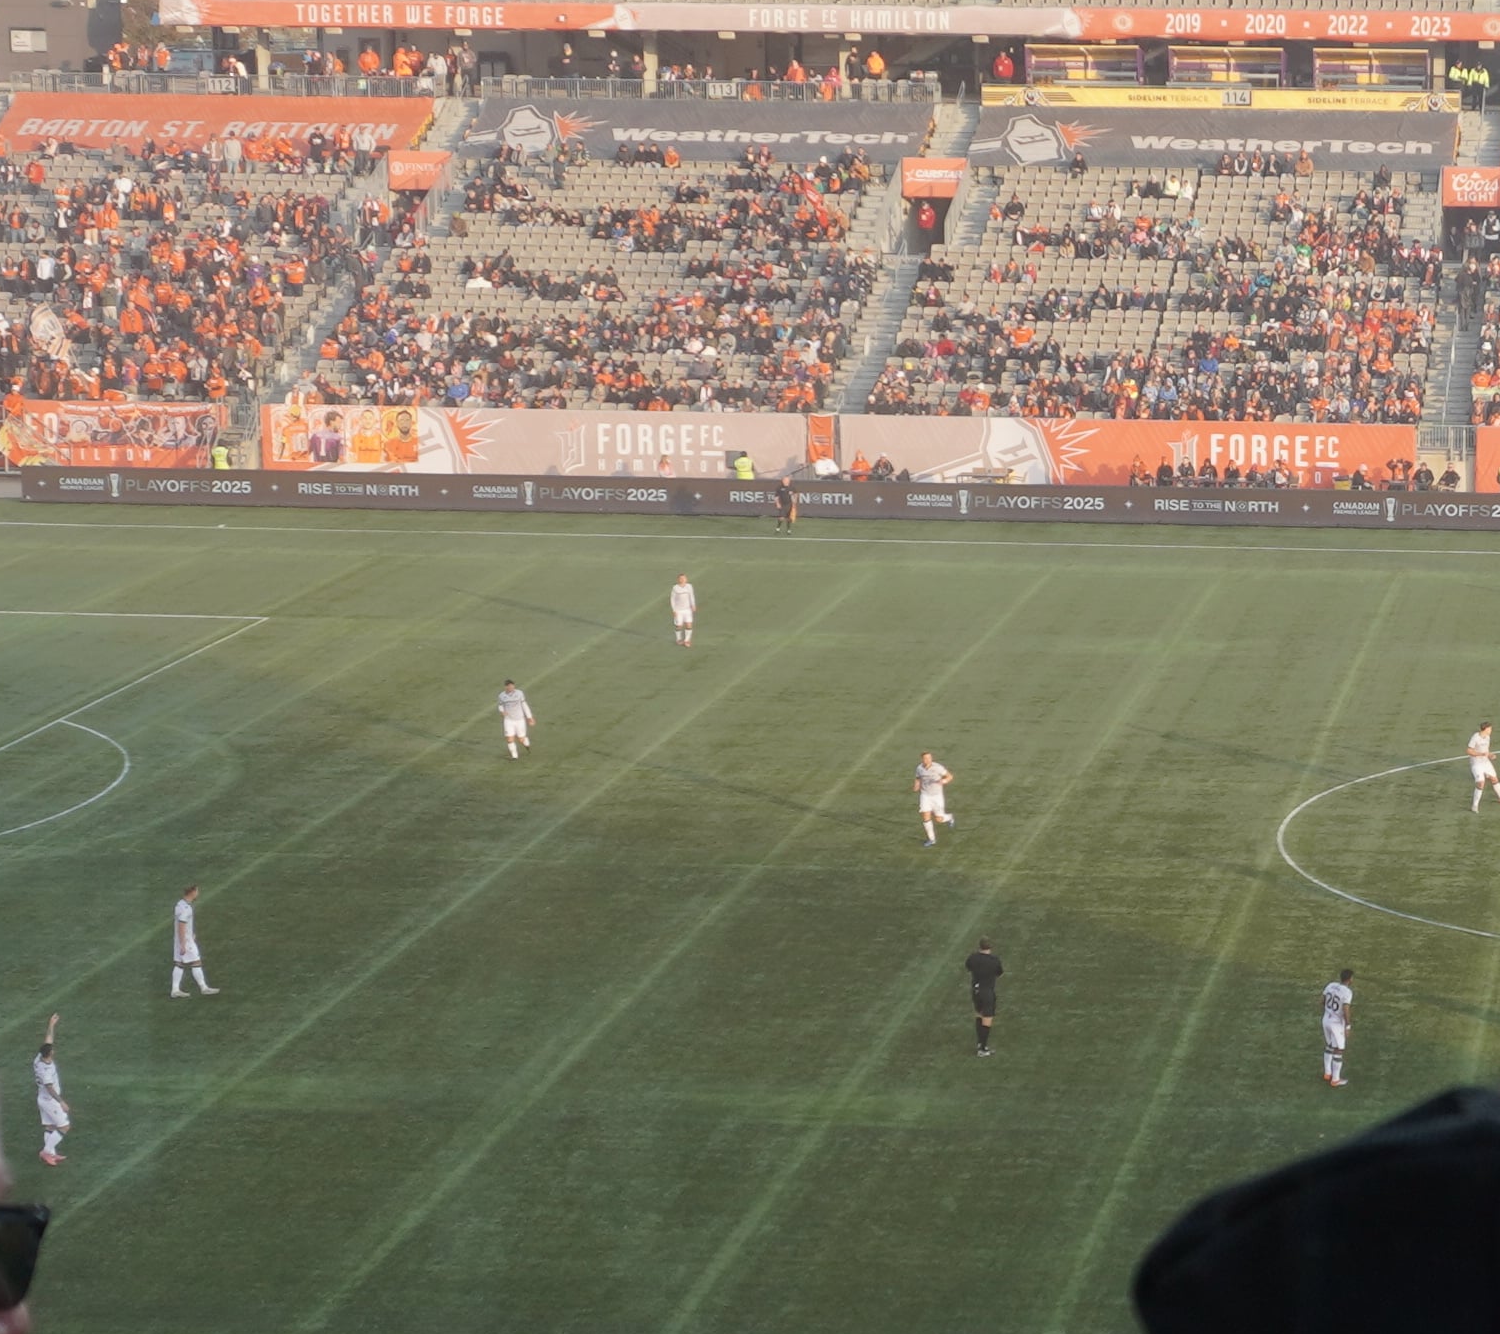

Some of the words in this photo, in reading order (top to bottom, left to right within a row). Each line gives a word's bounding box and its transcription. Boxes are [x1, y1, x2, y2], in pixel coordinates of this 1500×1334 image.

[295, 4, 394, 24] TOGETHER
[406, 5, 433, 25] WE
[445, 6, 506, 26] FORGE
[748, 8, 810, 29] FORGE
[822, 9, 838, 23] FC
[850, 9, 951, 30] HAMILTON
[1165, 13, 1201, 34] 2019
[1245, 14, 1286, 35] 2020
[1327, 15, 1368, 36] 2022
[1410, 15, 1451, 37] 2023
[210, 78, 231, 91] 112
[711, 83, 733, 96] 113
[1224, 91, 1247, 103] 114
[16, 118, 149, 138] BARTON
[158, 119, 204, 139] ST.
[611, 128, 908, 145] WeatherTech
[1130, 135, 1434, 155] WeatherTech
[1452, 173, 1499, 191] Coors
[1457, 191, 1494, 202] LIGHT
[596, 423, 694, 456] FORGE
[700, 424, 724, 447] FC
[1209, 433, 1309, 467] FORGE
[1315, 435, 1340, 459] FC
[59, 477, 103, 487] CANADIAN
[297, 482, 331, 495] RISE
[472, 484, 517, 493] CANADIAN
[729, 490, 764, 503] RISE
[907, 493, 952, 502] CANADIAN
[1154, 499, 1190, 511] RISE
[1333, 501, 1379, 510] CANADIAN
[1325, 992, 1341, 1012] 26
